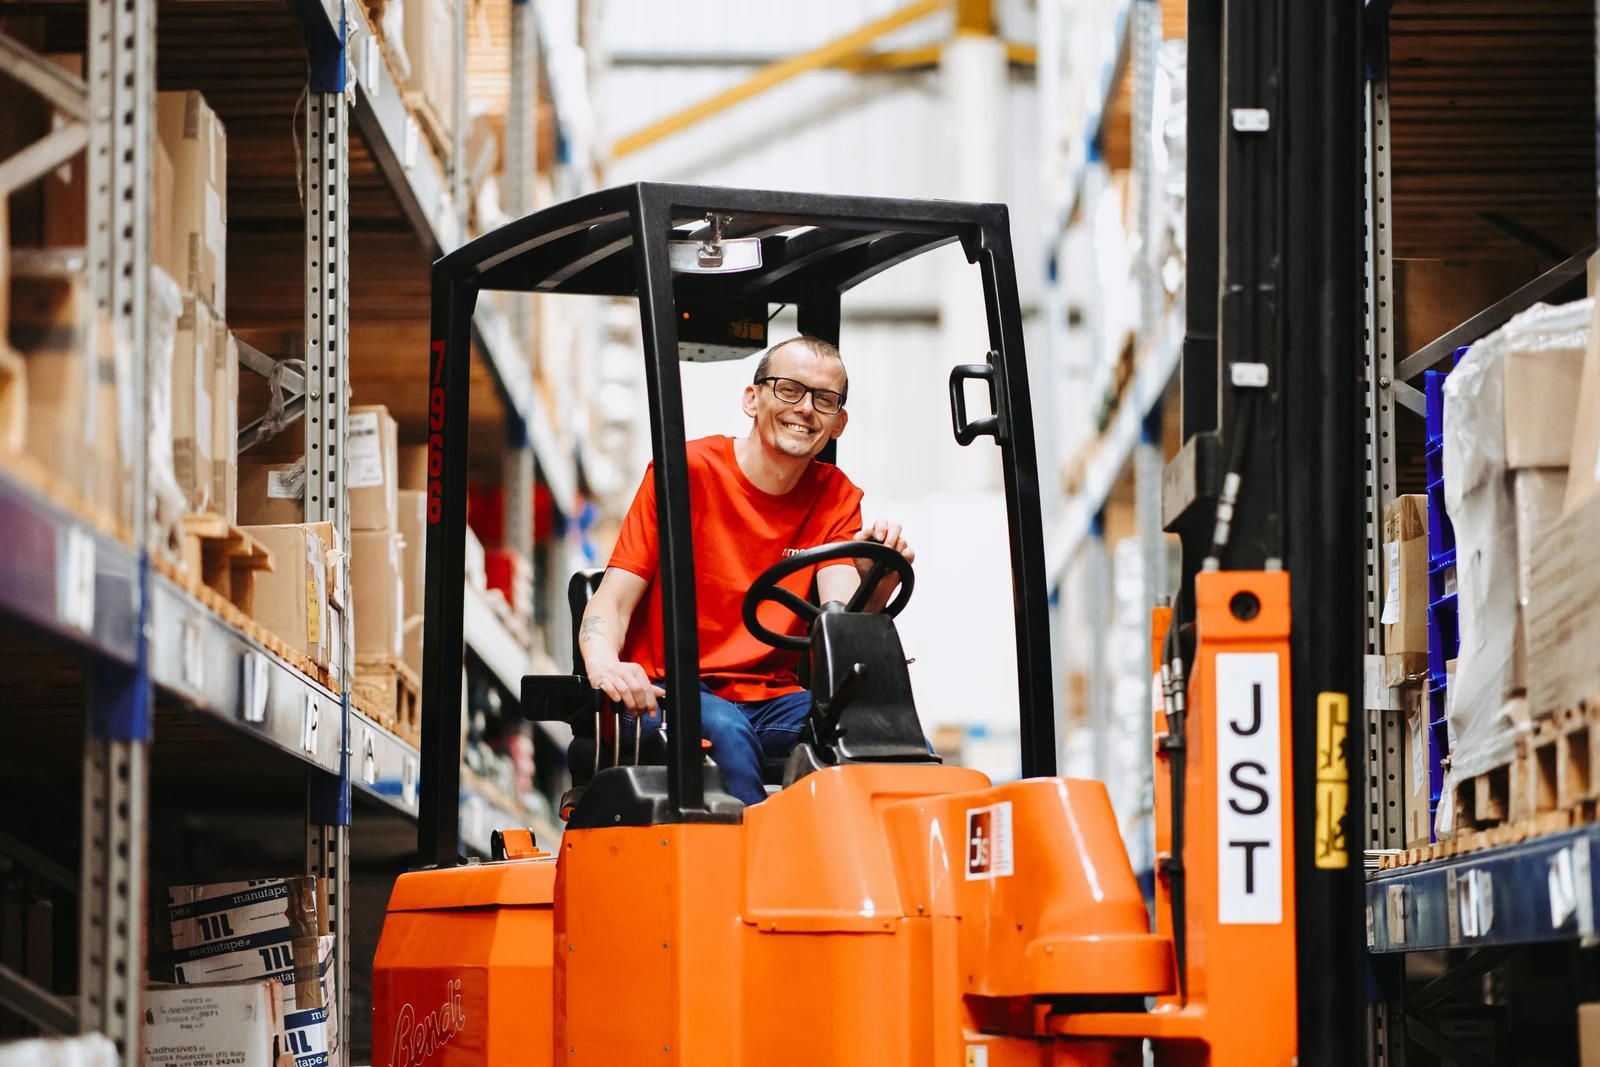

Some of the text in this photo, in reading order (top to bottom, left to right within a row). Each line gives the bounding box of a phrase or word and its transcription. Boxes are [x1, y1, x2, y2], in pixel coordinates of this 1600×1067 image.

[427, 340, 446, 525] 7966
[232, 885, 288, 904] manutape
[188, 939, 245, 957] manutape
[386, 978, 466, 1067] Bendi
[144, 1047, 151, 1055] &
[153, 1045, 198, 1055] adhesives
[150, 1054, 174, 1062] 50054
[175, 1053, 214, 1061] Fucecchio
[230, 1050, 246, 1058] Italy
[193, 1058, 213, 1067] 0571
[215, 1057, 246, 1066] 242457
